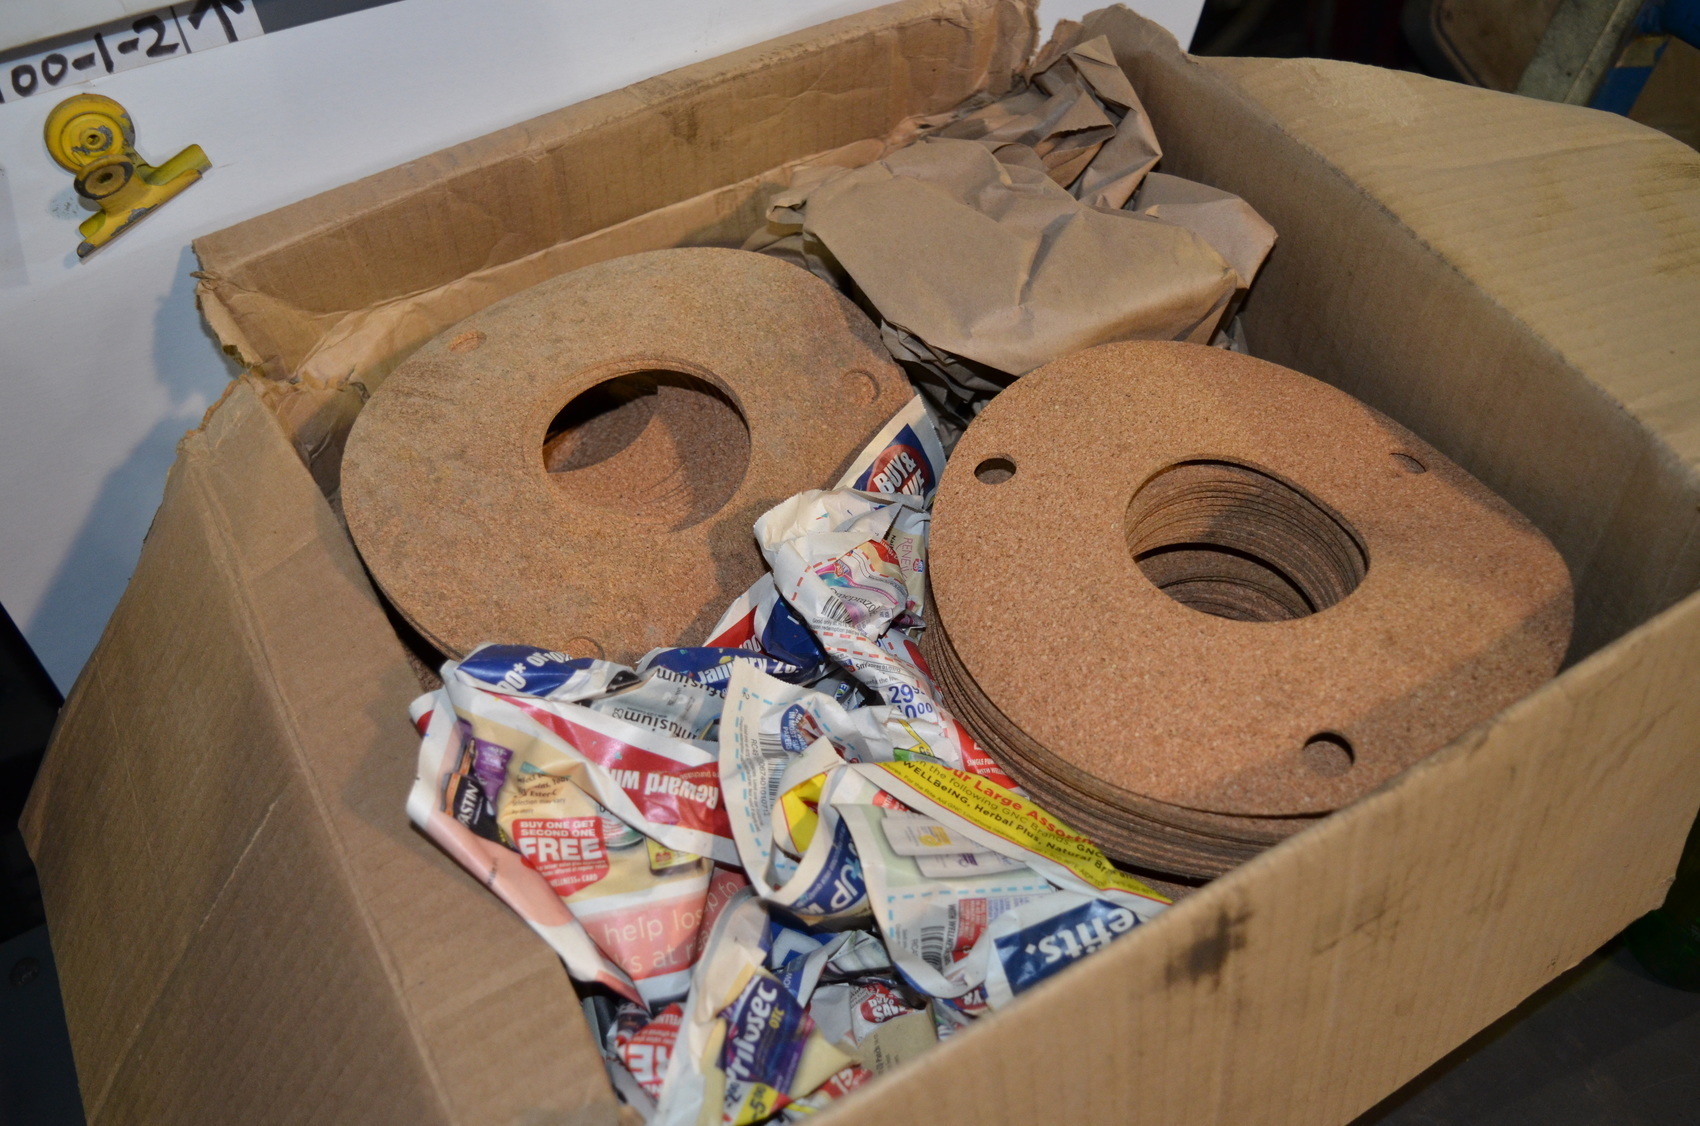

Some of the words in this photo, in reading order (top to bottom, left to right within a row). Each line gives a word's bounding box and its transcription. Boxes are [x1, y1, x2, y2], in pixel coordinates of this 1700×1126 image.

[0, 14, 180, 101] 00-1-2
[643, 772, 719, 810] Reward
[949, 777, 999, 811] following
[1001, 806, 1029, 825] GNC
[973, 780, 1023, 811] Large
[520, 821, 544, 829] BUY
[546, 820, 570, 830] ONE
[573, 819, 596, 829] GET
[521, 828, 569, 837] SECOND
[572, 828, 596, 837] ONE
[974, 804, 1013, 827] Herbal
[1016, 824, 1042, 846] Plus,
[1046, 841, 1092, 863] Natural
[518, 836, 603, 863] FREE
[604, 916, 664, 946] help
[652, 943, 679, 969] at
